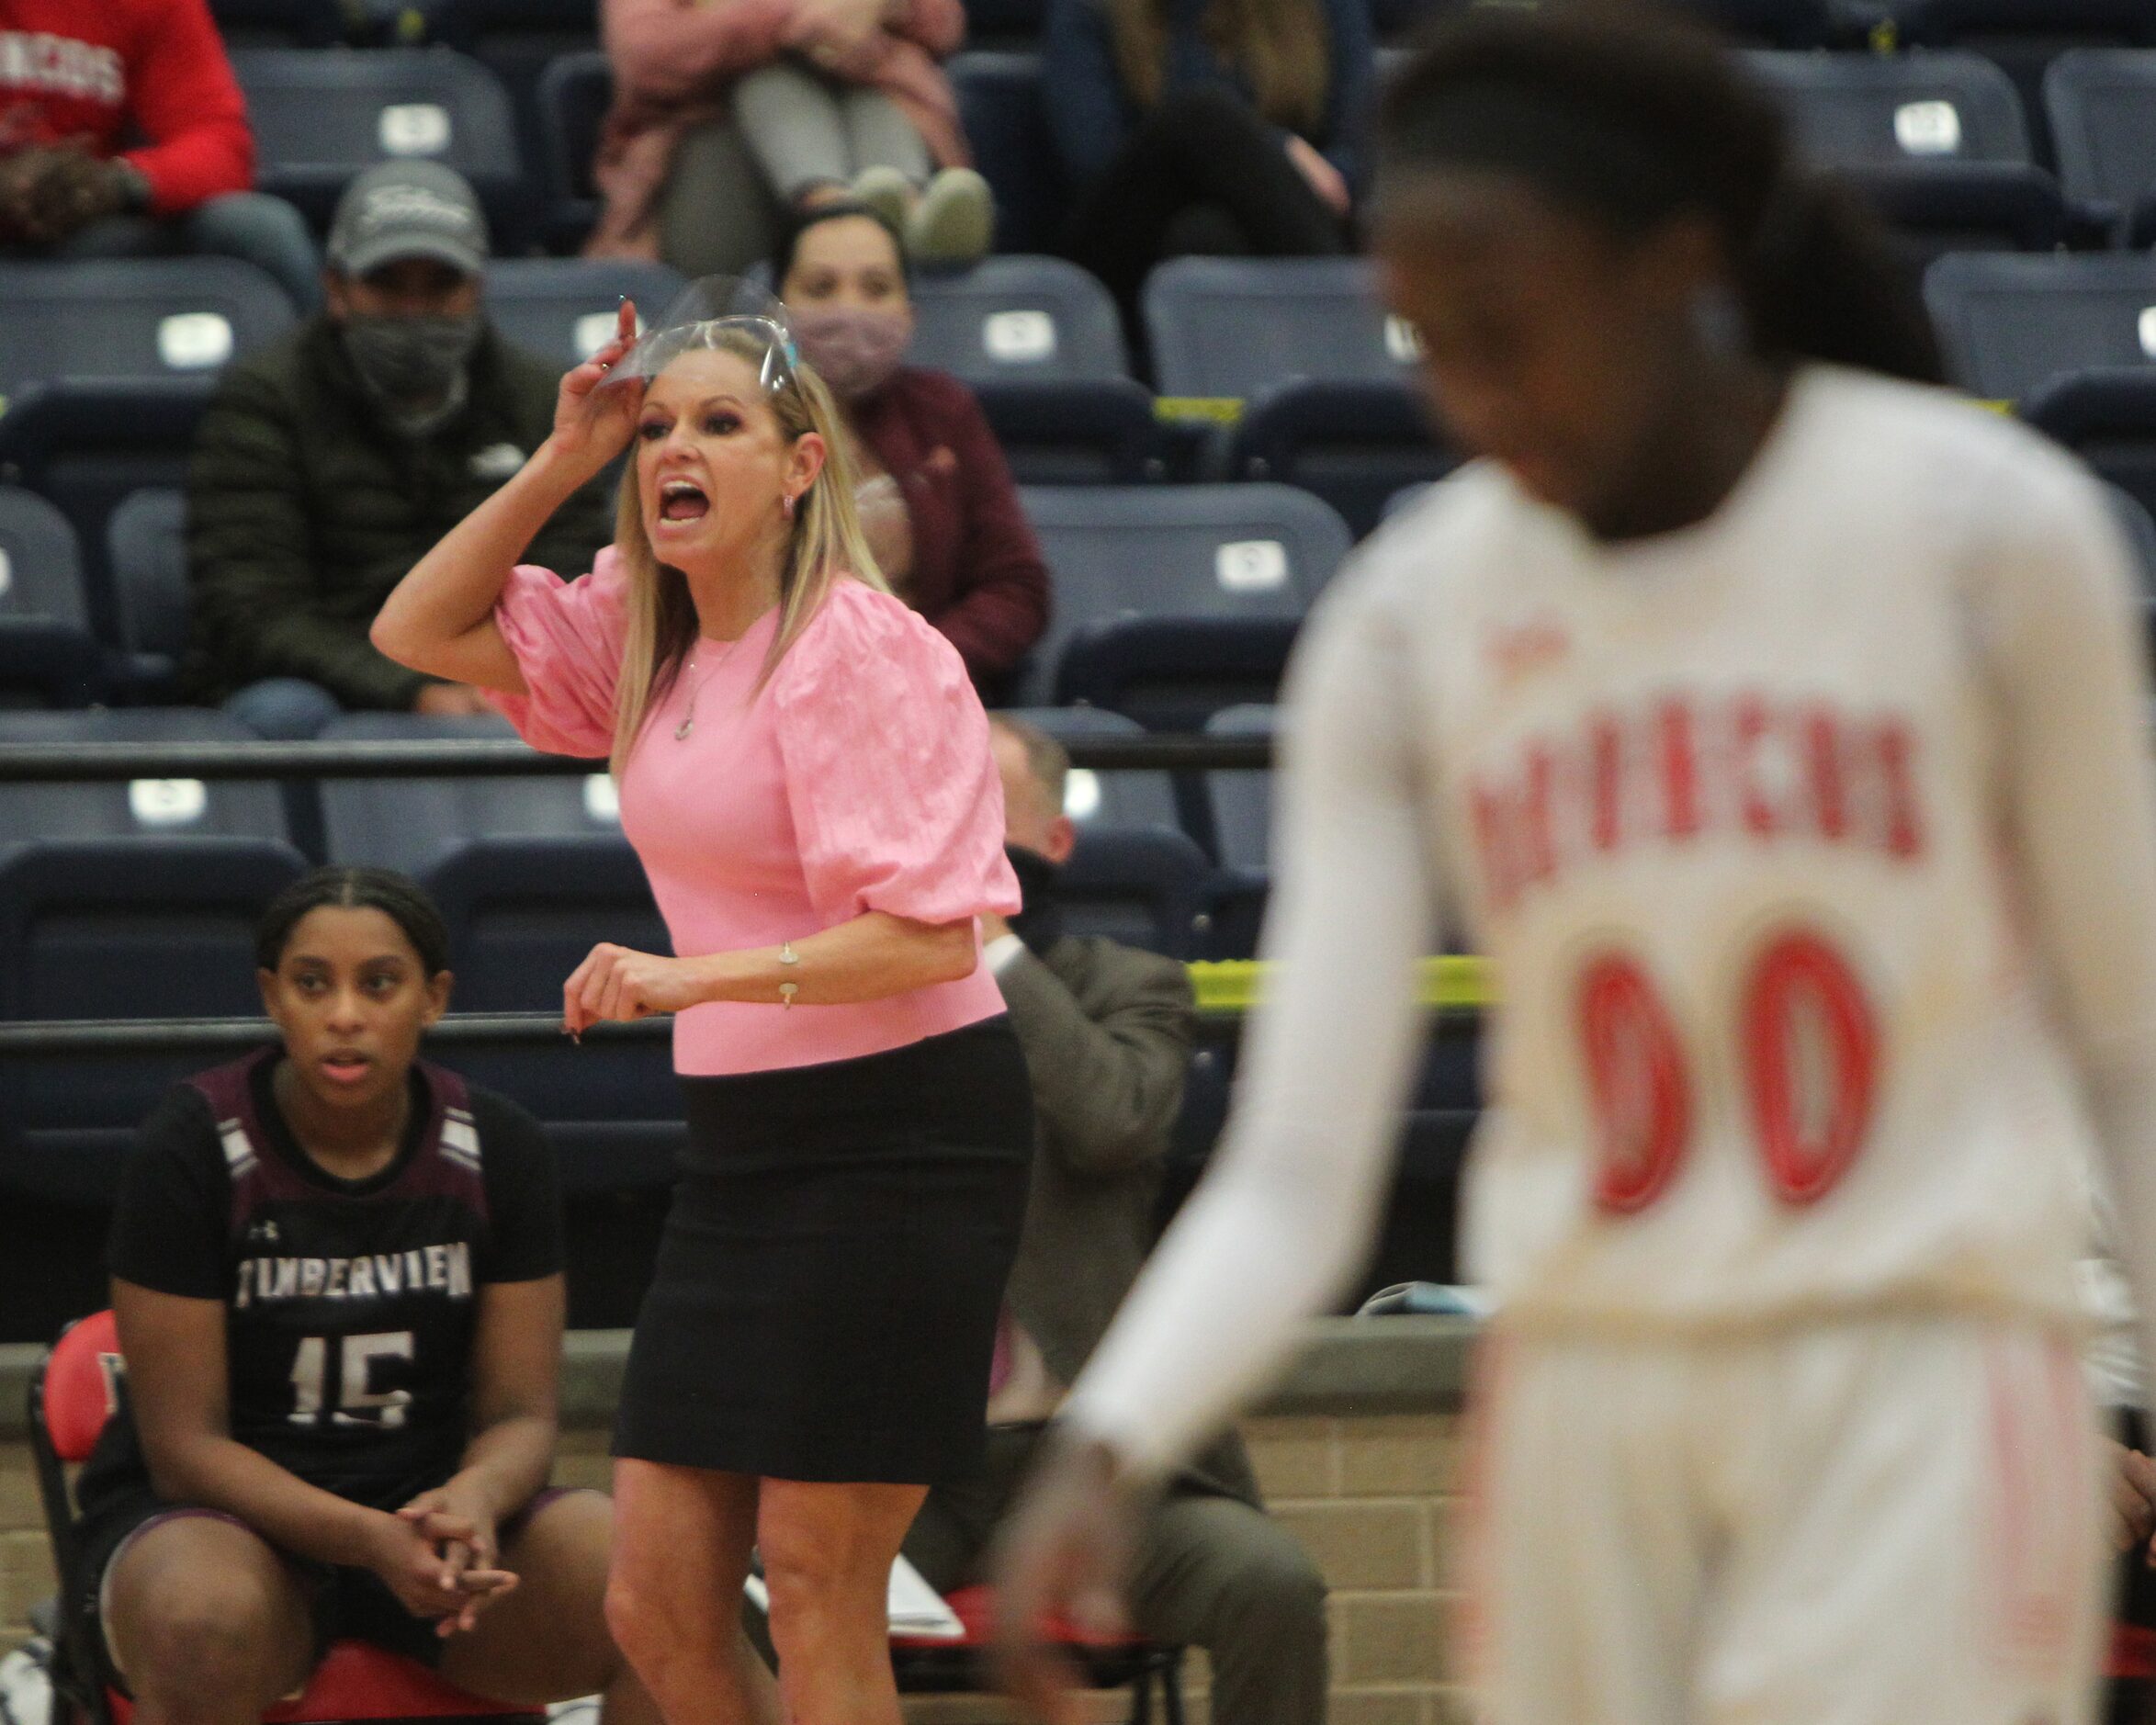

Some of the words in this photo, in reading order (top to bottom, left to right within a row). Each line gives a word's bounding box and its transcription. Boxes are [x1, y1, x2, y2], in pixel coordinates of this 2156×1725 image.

[1575, 930, 1879, 1222] 00
[235, 1242, 471, 1308] TIMBERVIEW
[286, 1331, 414, 1429] 15
